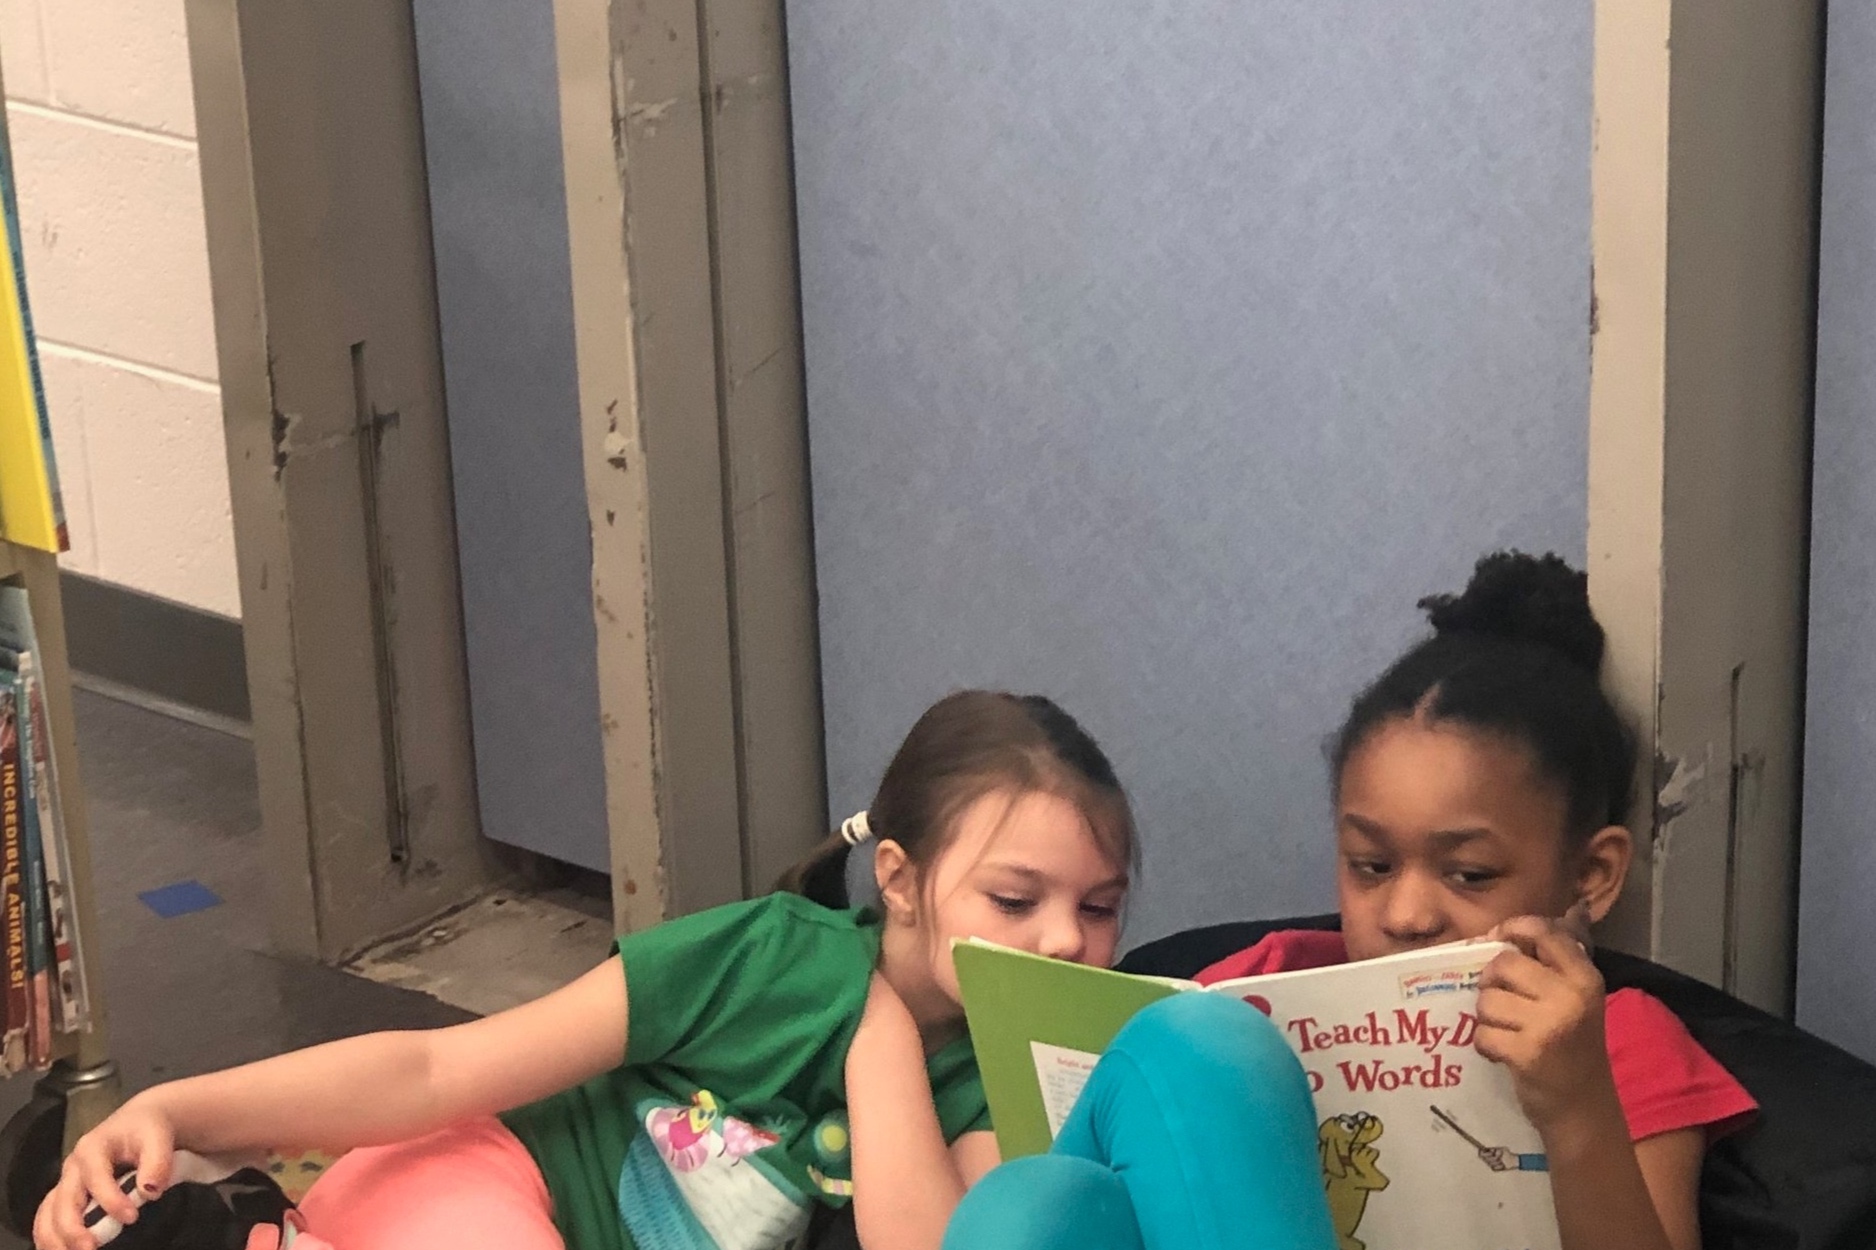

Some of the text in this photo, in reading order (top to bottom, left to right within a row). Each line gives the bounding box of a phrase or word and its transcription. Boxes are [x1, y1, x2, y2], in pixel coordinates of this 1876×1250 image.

[3, 763, 24, 989] INCREDIBLE ANIMALS!
[1288, 1011, 1391, 1053] Teach
[1393, 1008, 1449, 1053] My
[1336, 1054, 1463, 1092] Words
